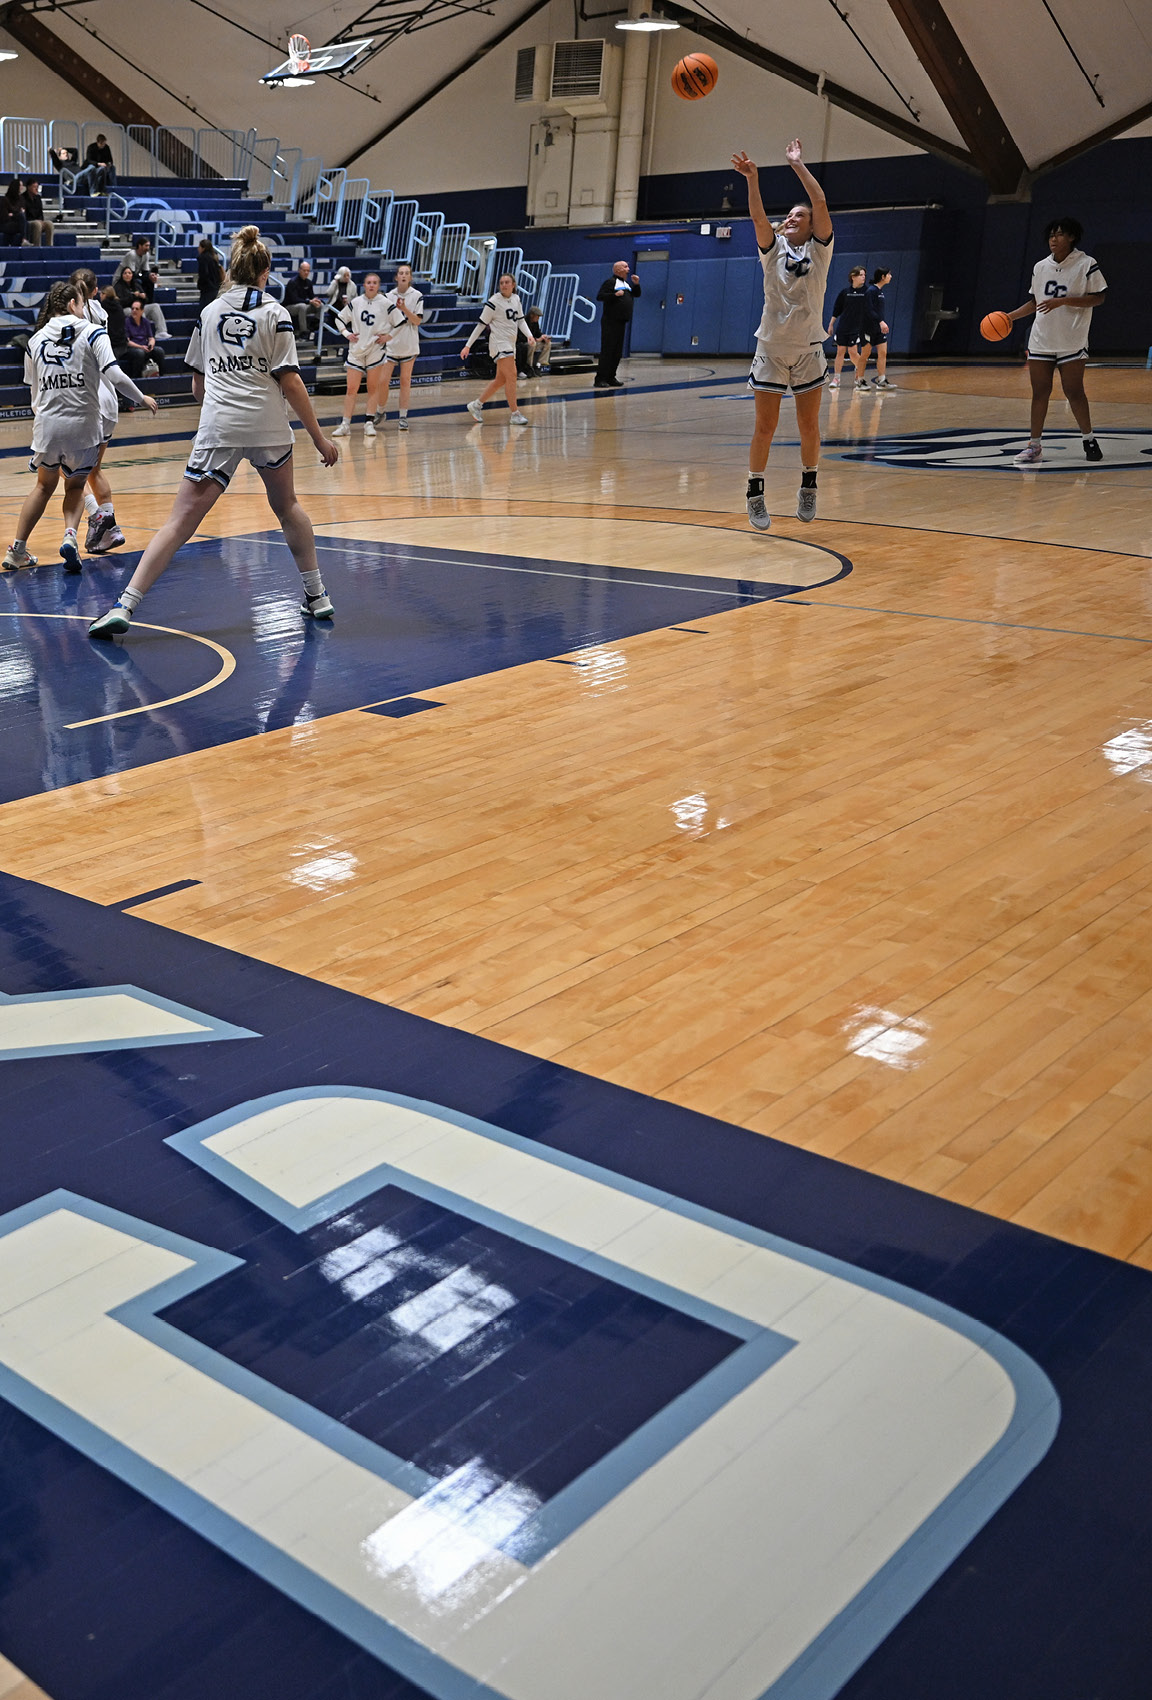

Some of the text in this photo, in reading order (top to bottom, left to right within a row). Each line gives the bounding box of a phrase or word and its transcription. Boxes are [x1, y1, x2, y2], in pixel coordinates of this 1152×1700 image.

[1044, 280, 1067, 298] CC
[360, 310, 375, 326] CC
[208, 355, 268, 375] CAMELS
[39, 373, 85, 392] AMELS
